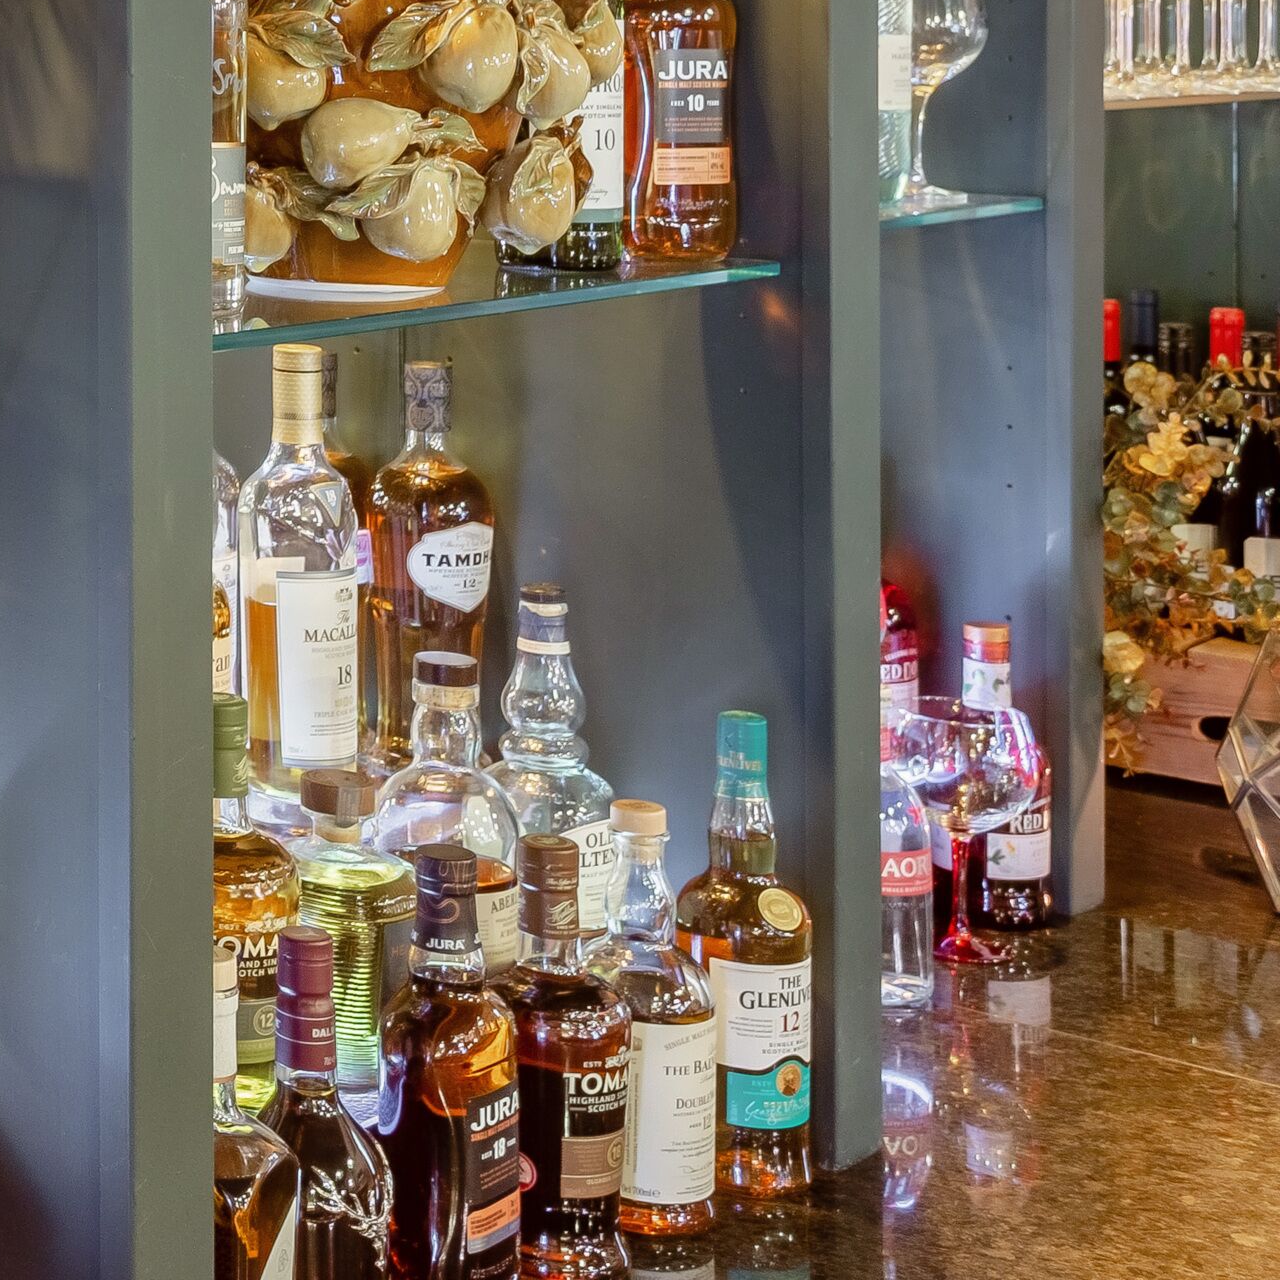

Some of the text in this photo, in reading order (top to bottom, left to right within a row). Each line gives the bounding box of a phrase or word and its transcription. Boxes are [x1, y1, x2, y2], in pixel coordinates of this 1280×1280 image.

[658, 60, 728, 81] JURA
[686, 94, 705, 112] 10
[594, 128, 616, 151] 10
[422, 551, 489, 567] TAMDH
[462, 578, 477, 589] 12
[337, 664, 352, 686] 18
[1009, 813, 1041, 834] RED
[425, 937, 466, 951] JURA
[778, 974, 801, 990] THE
[259, 1013, 274, 1029] 12
[781, 1010, 800, 1033] 12
[664, 1035, 690, 1051] SINGLE
[762, 1047, 791, 1055] SCOTCH
[663, 1065, 690, 1076] THE
[569, 1093, 616, 1105] HIGHLAND
[470, 1090, 520, 1132] JURA
[587, 1102, 618, 1113] SCOTCH
[493, 1137, 506, 1160] 18
